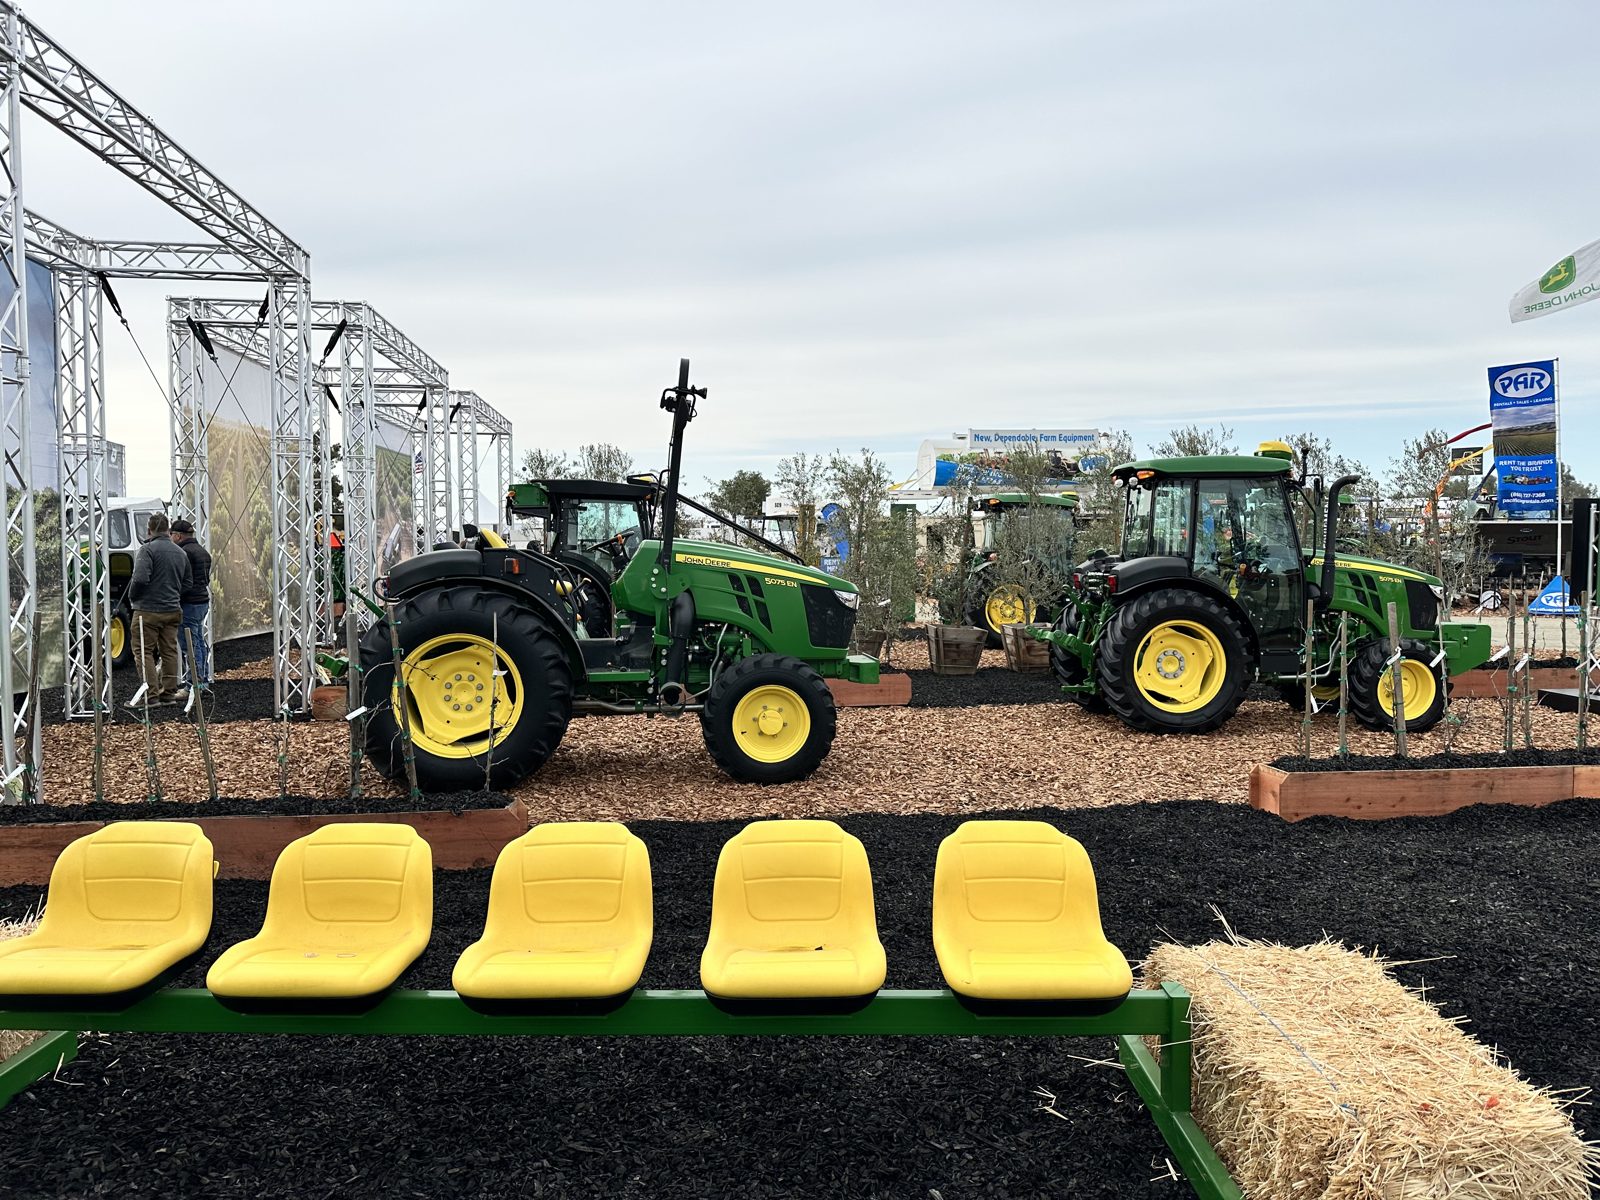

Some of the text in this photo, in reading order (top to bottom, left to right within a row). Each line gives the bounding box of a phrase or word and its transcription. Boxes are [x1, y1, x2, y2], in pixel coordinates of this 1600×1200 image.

[1499, 372, 1545, 394] PAR
[974, 433, 992, 443] New,
[1040, 433, 1056, 441] Farm
[1059, 433, 1094, 443] Equipment
[684, 556, 731, 568] JOHN DEERE
[764, 577, 798, 588] 5075 EN
